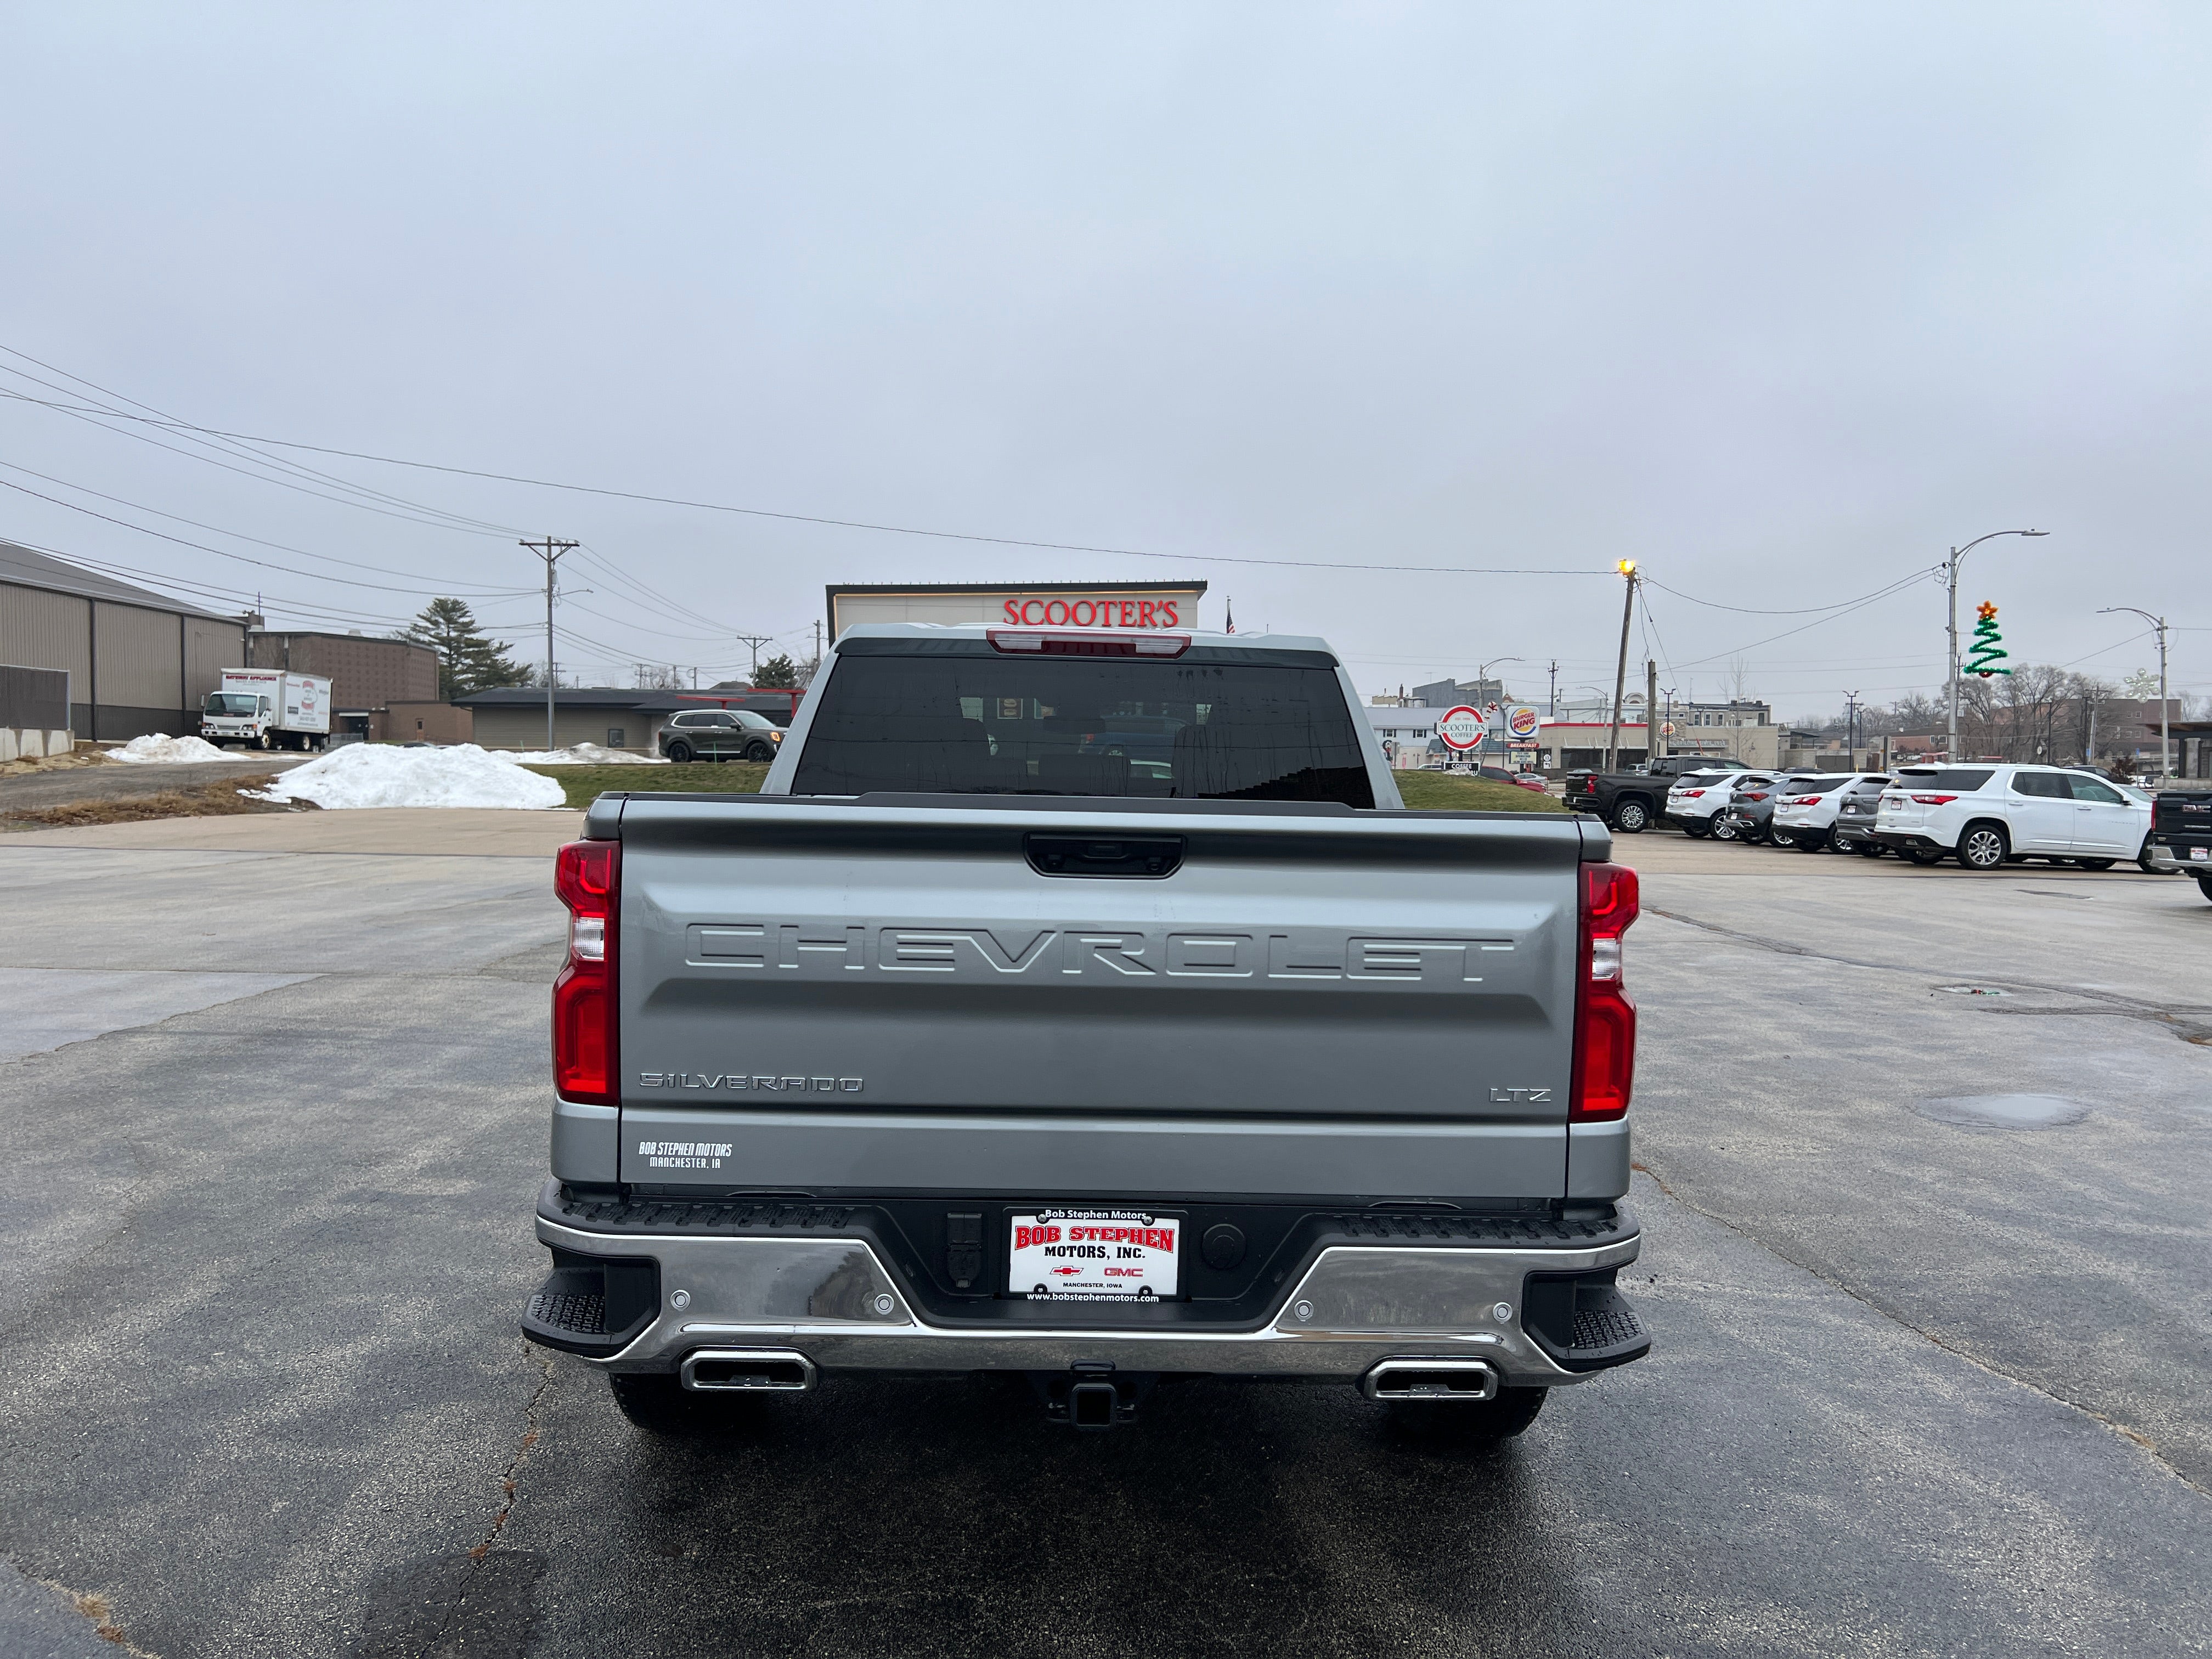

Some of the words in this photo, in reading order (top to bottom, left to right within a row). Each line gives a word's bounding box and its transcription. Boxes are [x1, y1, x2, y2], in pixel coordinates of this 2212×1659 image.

[1003, 599, 1178, 627] SCOOTER'S
[1513, 712, 1534, 723] BURGER
[1513, 717, 1535, 731] KING
[685, 923, 1514, 983] CHEVROLET
[639, 1073, 864, 1092] SILVERADO
[1489, 1088, 1551, 1102] LTZ
[639, 1141, 657, 1155] BOB
[657, 1142, 695, 1156] STEPHEN
[695, 1143, 733, 1157] MOTORS
[712, 1158, 720, 1169] IA
[1045, 1209, 1065, 1218] Bob
[1067, 1210, 1109, 1220] Stephen
[1111, 1211, 1147, 1220] Motors
[1015, 1226, 1061, 1250] BOB
[1069, 1226, 1175, 1254] STEPHEN
[1044, 1246, 1110, 1260] MOTORS,
[1116, 1248, 1146, 1259] INC.
[1104, 1267, 1143, 1277] GMC
[1026, 1292, 1159, 1303] www.bobstephenmotors.com
